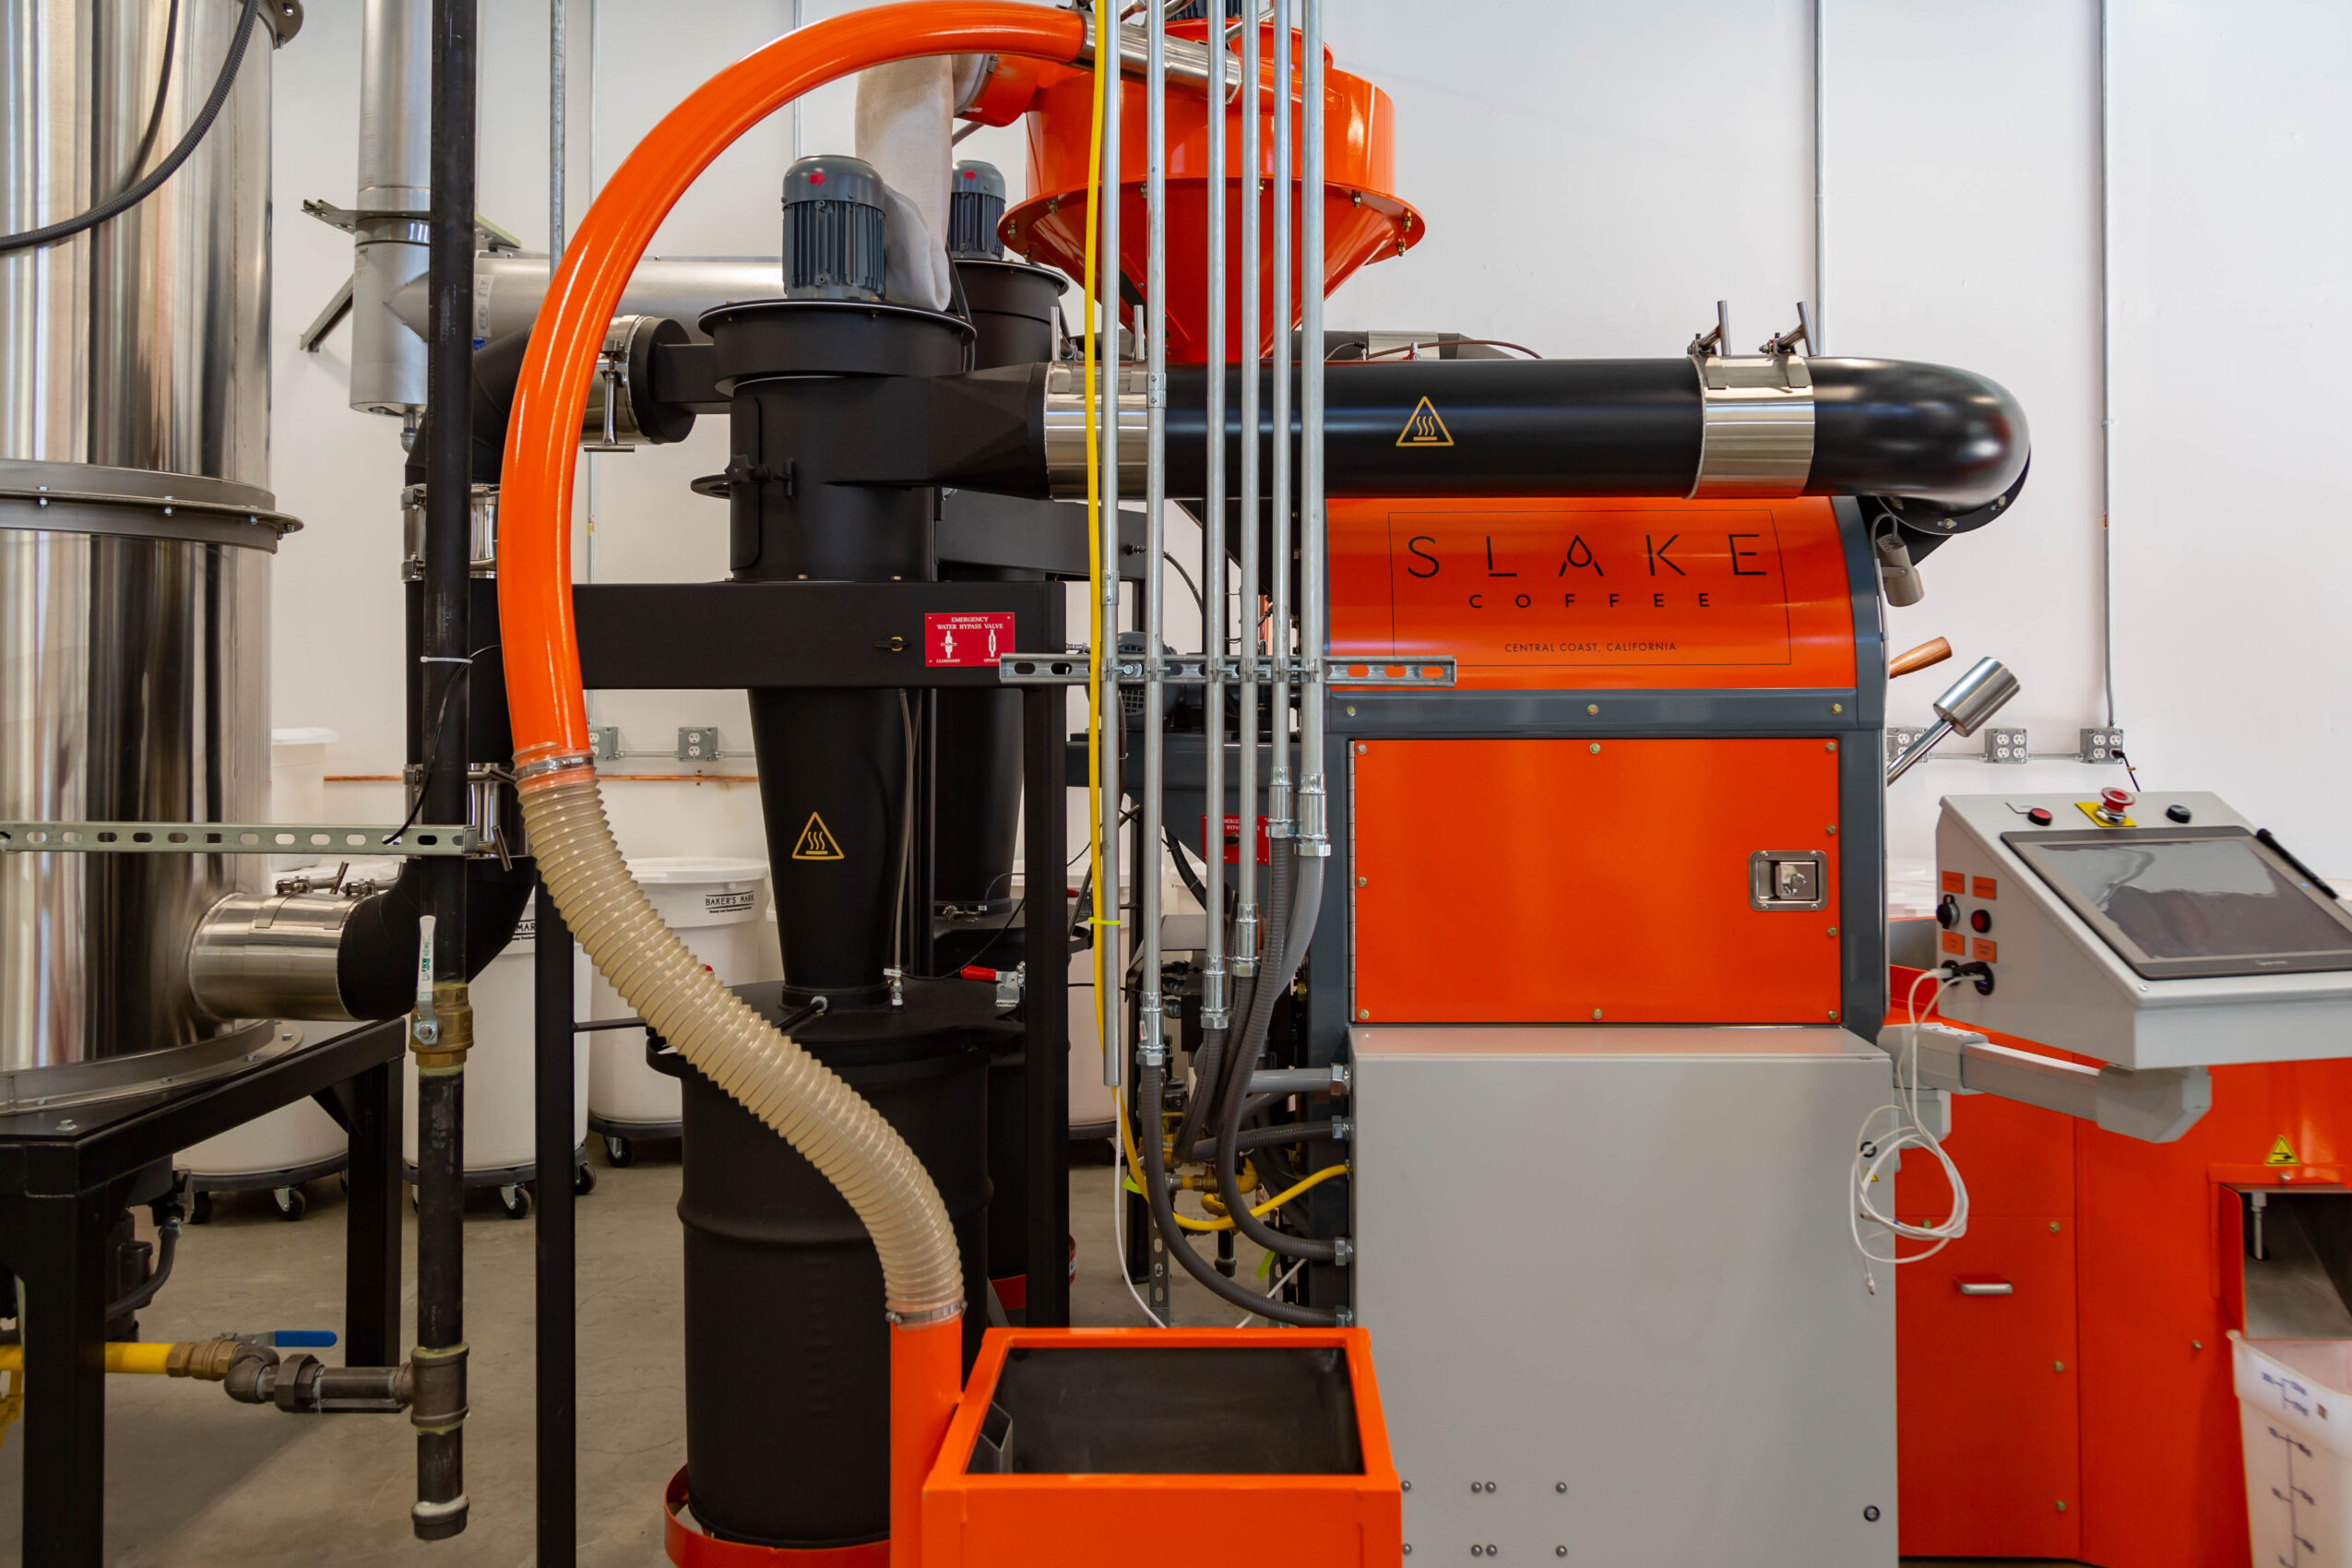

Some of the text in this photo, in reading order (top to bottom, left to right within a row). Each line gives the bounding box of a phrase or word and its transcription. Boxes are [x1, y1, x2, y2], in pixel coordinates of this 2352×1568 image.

[1408, 534, 1767, 578] SLAKE
[1468, 593, 1710, 609] COFFEE
[1504, 642, 1677, 653] CENTRAL COAST, CALIFORNIA
[705, 897, 737, 906] BAKER'S
[517, 922, 535, 932] MAR
